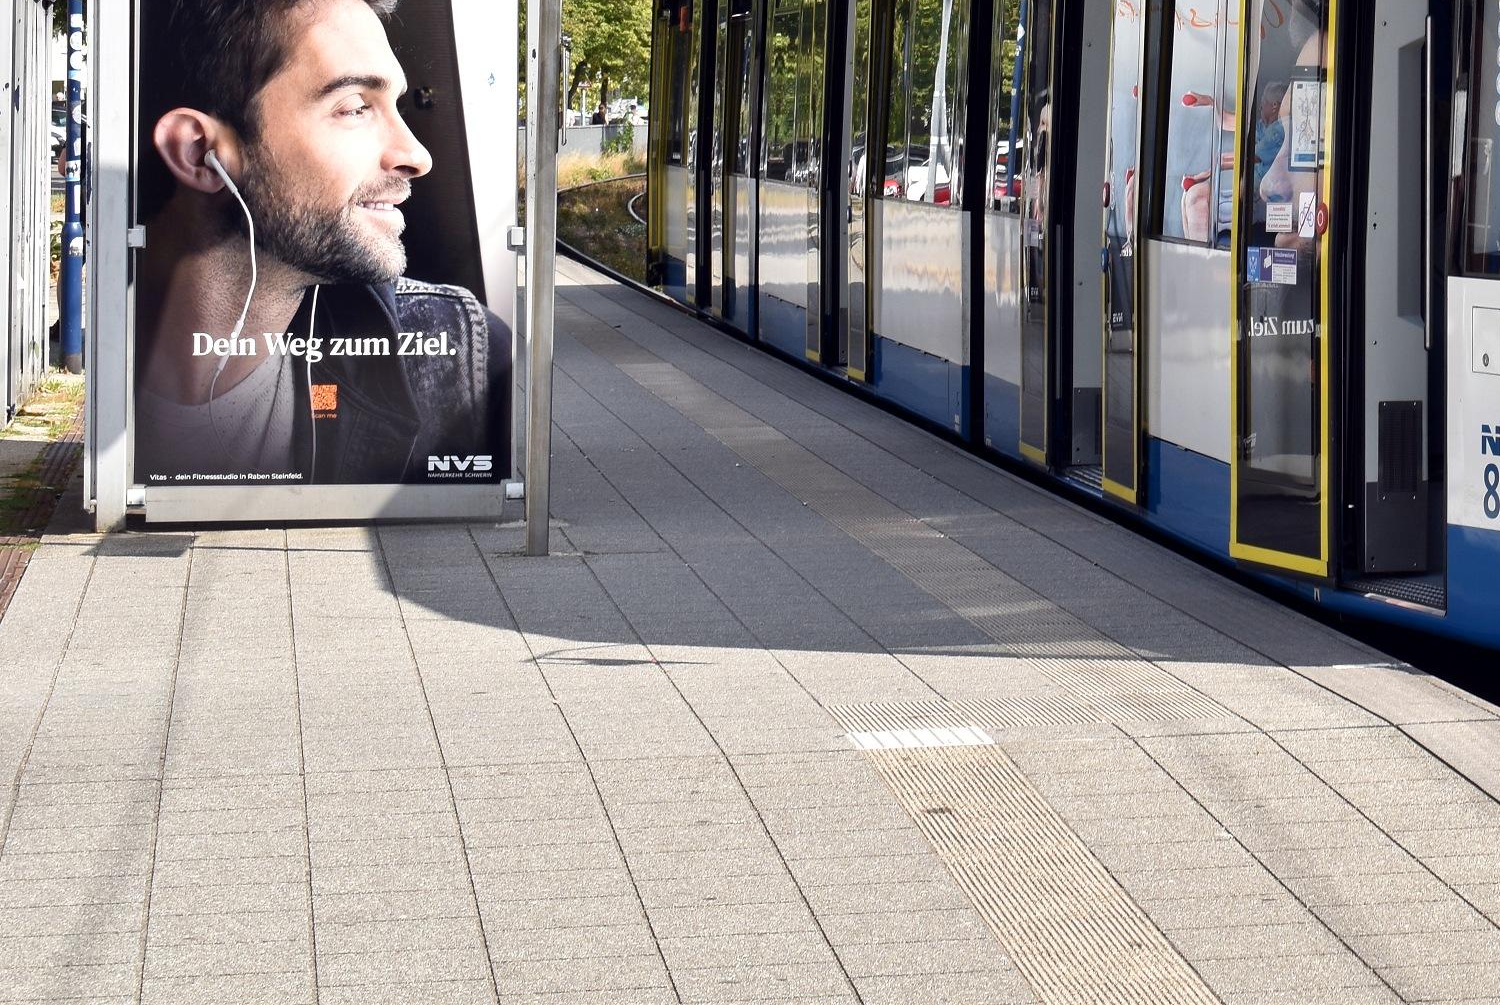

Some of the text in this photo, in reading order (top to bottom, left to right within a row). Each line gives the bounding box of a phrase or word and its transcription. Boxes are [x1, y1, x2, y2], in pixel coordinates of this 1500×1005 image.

[192, 331, 457, 363] Dein Weg zum Ziel.
[428, 455, 492, 471] NVS
[149, 473, 168, 481] Vitas
[271, 472, 303, 480] Steinfeld.
